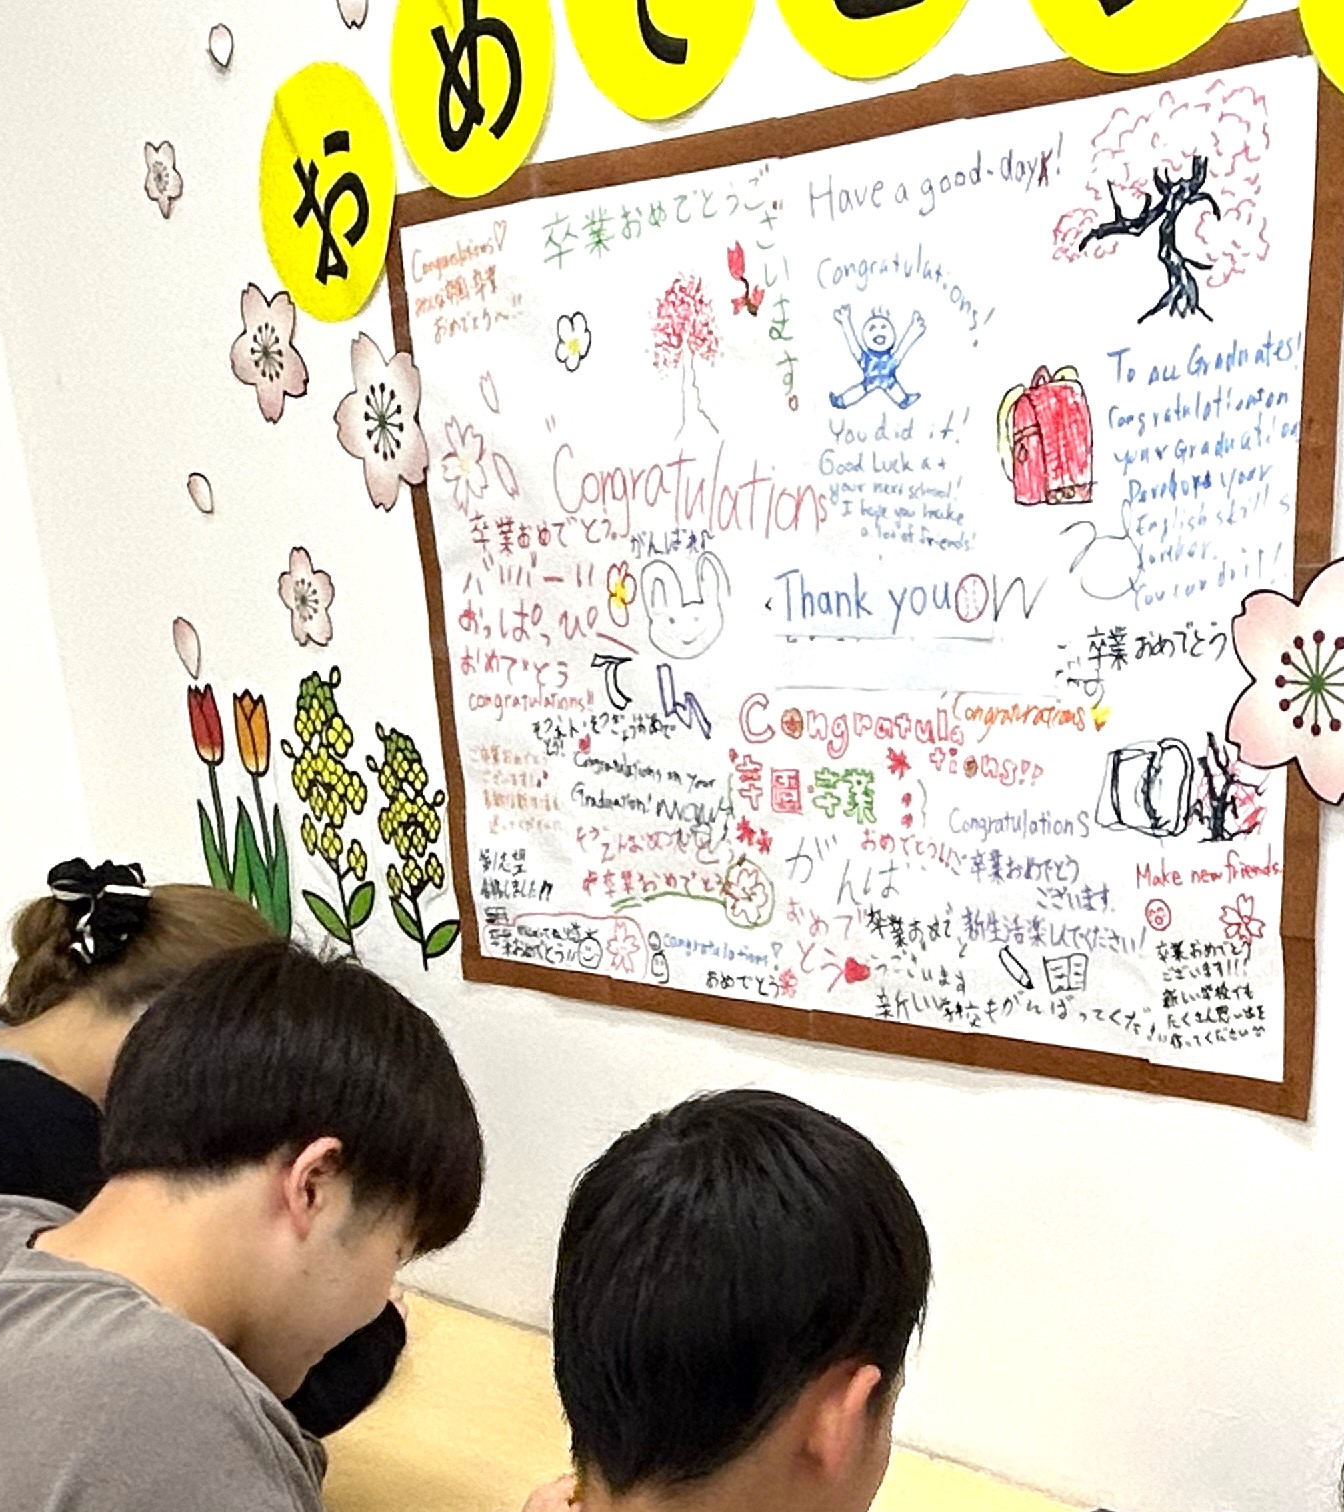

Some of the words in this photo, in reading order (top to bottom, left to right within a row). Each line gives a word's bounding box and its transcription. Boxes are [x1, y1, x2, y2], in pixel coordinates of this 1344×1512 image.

[293, 130, 369, 285] お
[809, 174, 883, 221] Have
[895, 183, 909, 203] a
[1107, 348, 1135, 383] To
[829, 418, 867, 444] You
[819, 449, 864, 475] Good
[554, 440, 827, 539] Congratulations
[774, 568, 873, 622] Thank
[888, 581, 951, 635] you
[1137, 857, 1183, 889] Make
